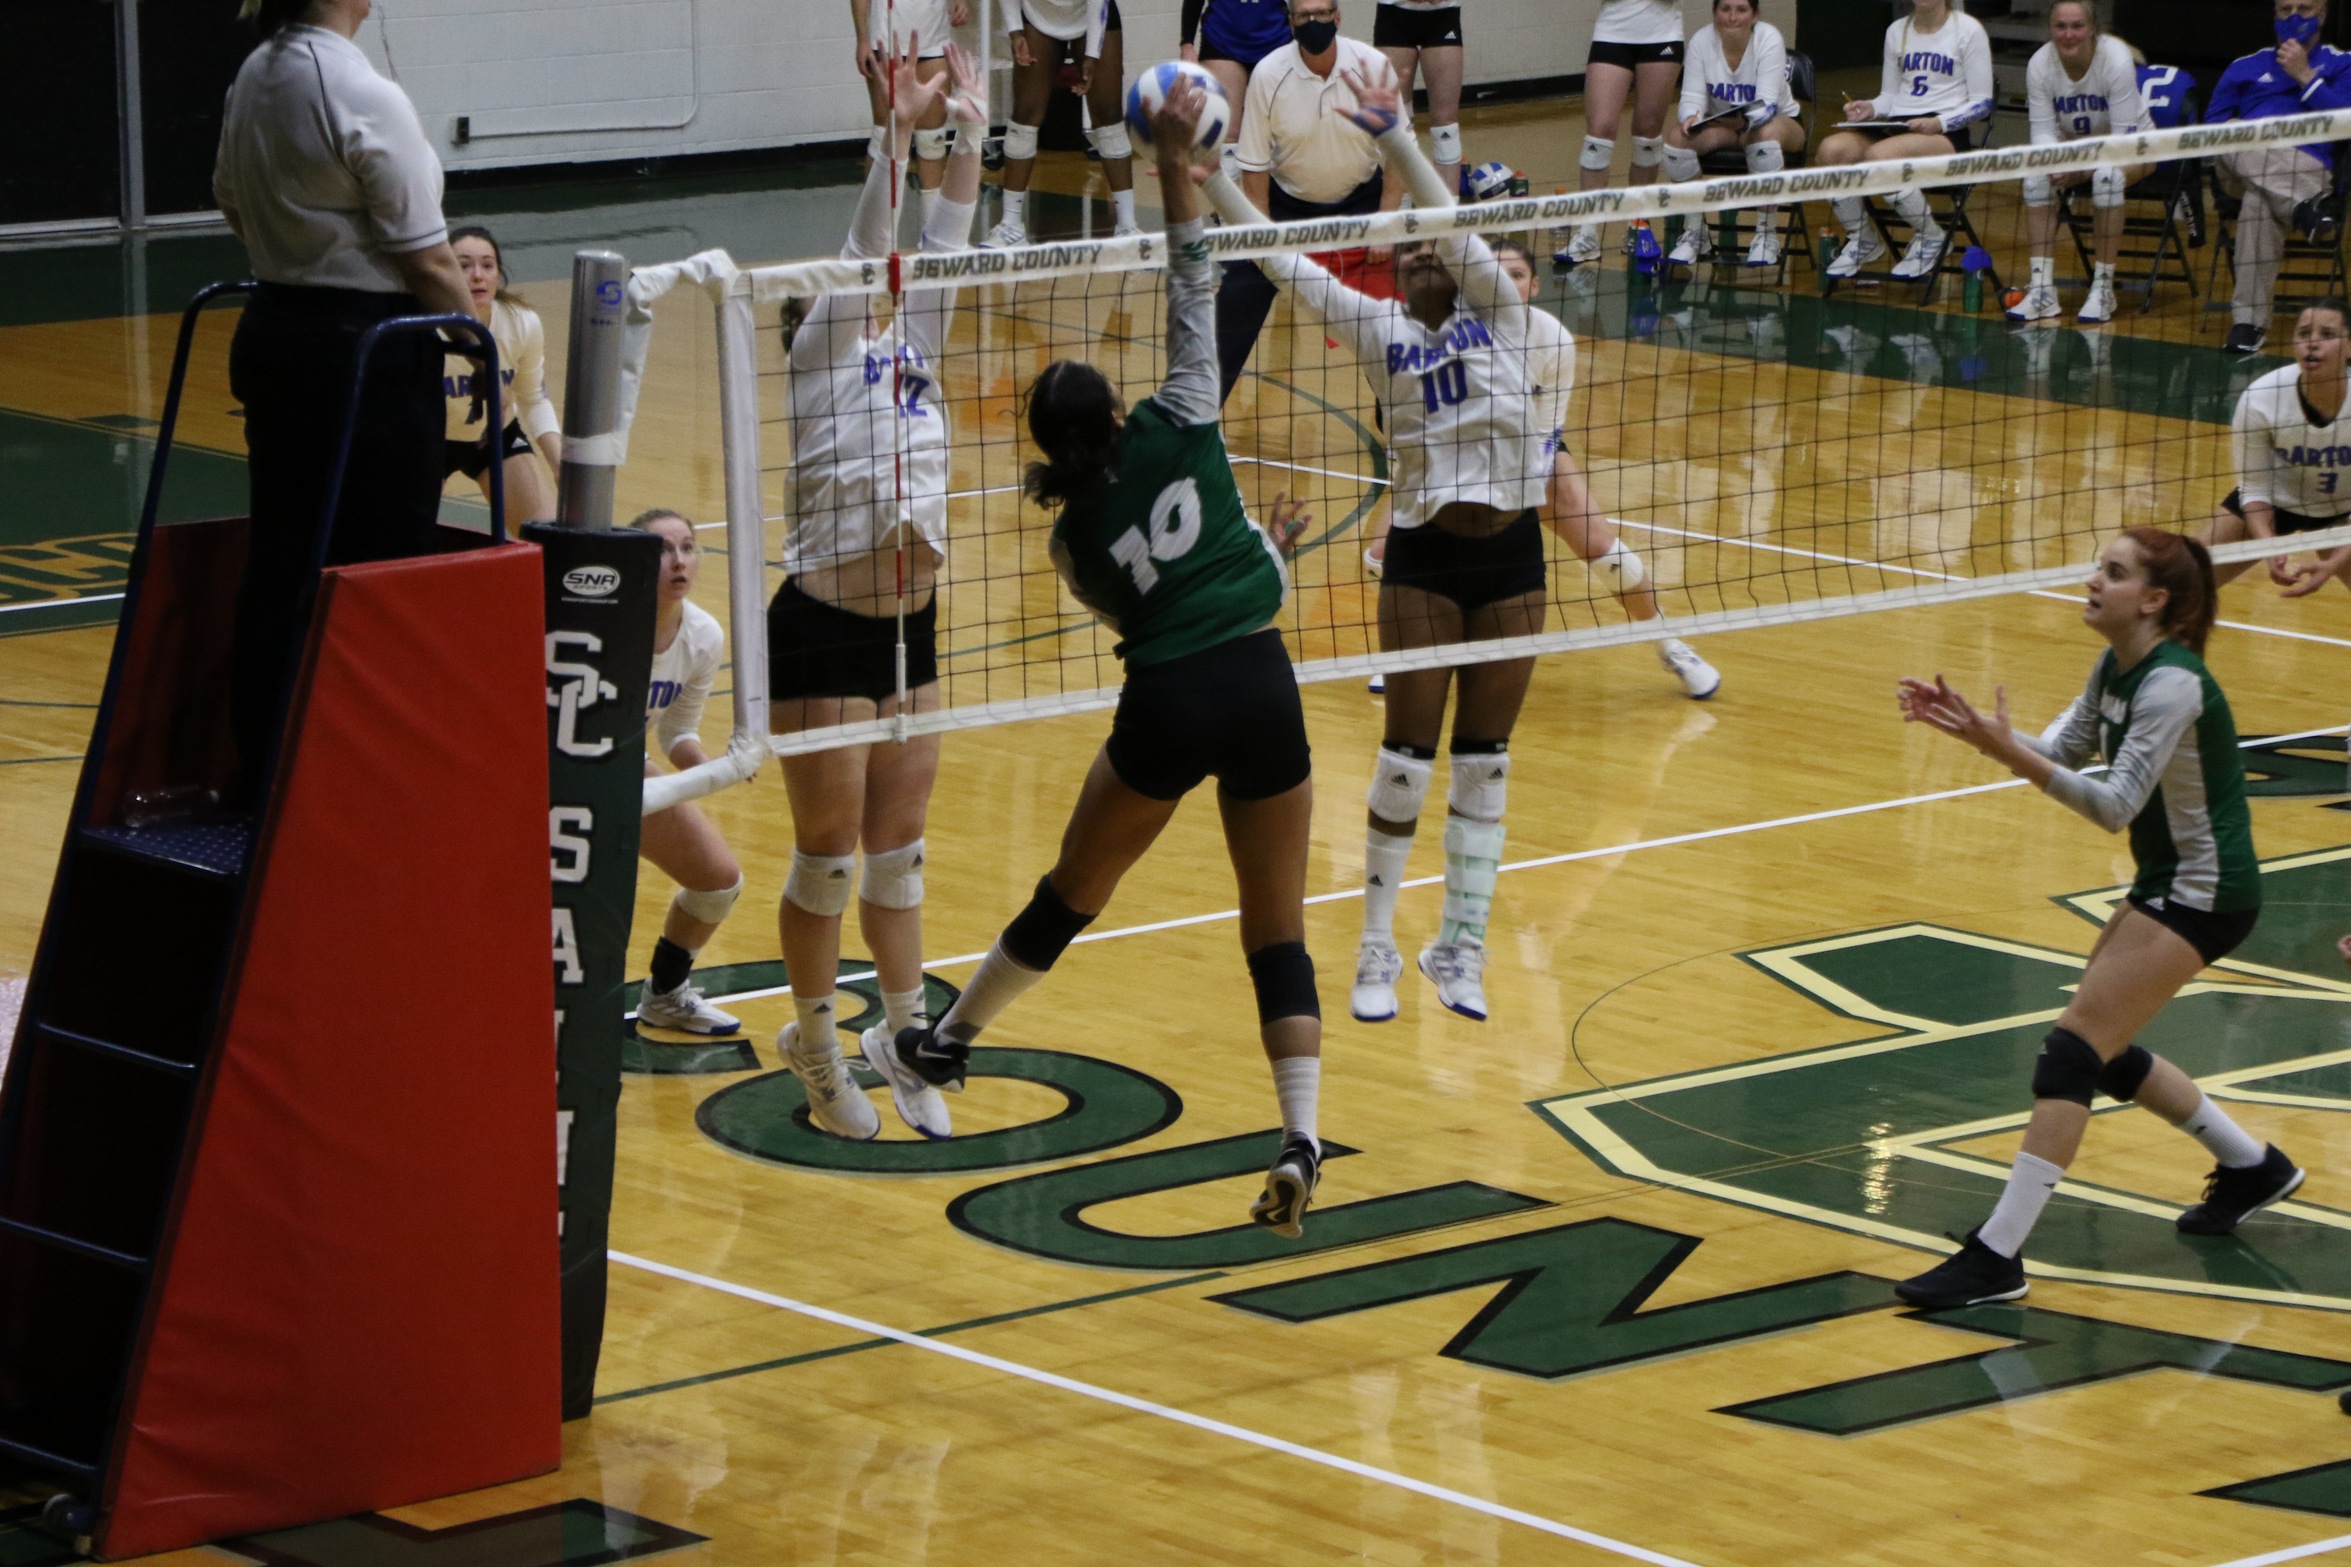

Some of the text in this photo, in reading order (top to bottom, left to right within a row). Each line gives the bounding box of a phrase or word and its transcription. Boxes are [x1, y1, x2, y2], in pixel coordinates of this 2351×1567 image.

[1897, 52, 1954, 77] ARTON
[1706, 82, 1757, 102] BARTO
[1910, 75, 1929, 97] 6
[2073, 116, 2092, 135] 9
[912, 253, 1006, 279] SEWARD
[1012, 243, 1103, 270] COUNTY
[1204, 226, 1278, 253] EWARD
[1283, 220, 1371, 246] COUNTY
[1453, 202, 1538, 228] SEWARD
[1542, 193, 1625, 219] COUNTY
[1703, 175, 1784, 202] SEWARD
[1789, 168, 1870, 194] COUNTY
[1944, 149, 2023, 177] SEWARD
[2026, 142, 2106, 169] COUNTY
[2178, 124, 2257, 150] SEWARD
[2260, 115, 2335, 142] COUNTY
[1420, 359, 1468, 414] 10
[2316, 472, 2338, 495] 3
[1108, 476, 1202, 597] 10
[565, 573, 616, 586] SNA
